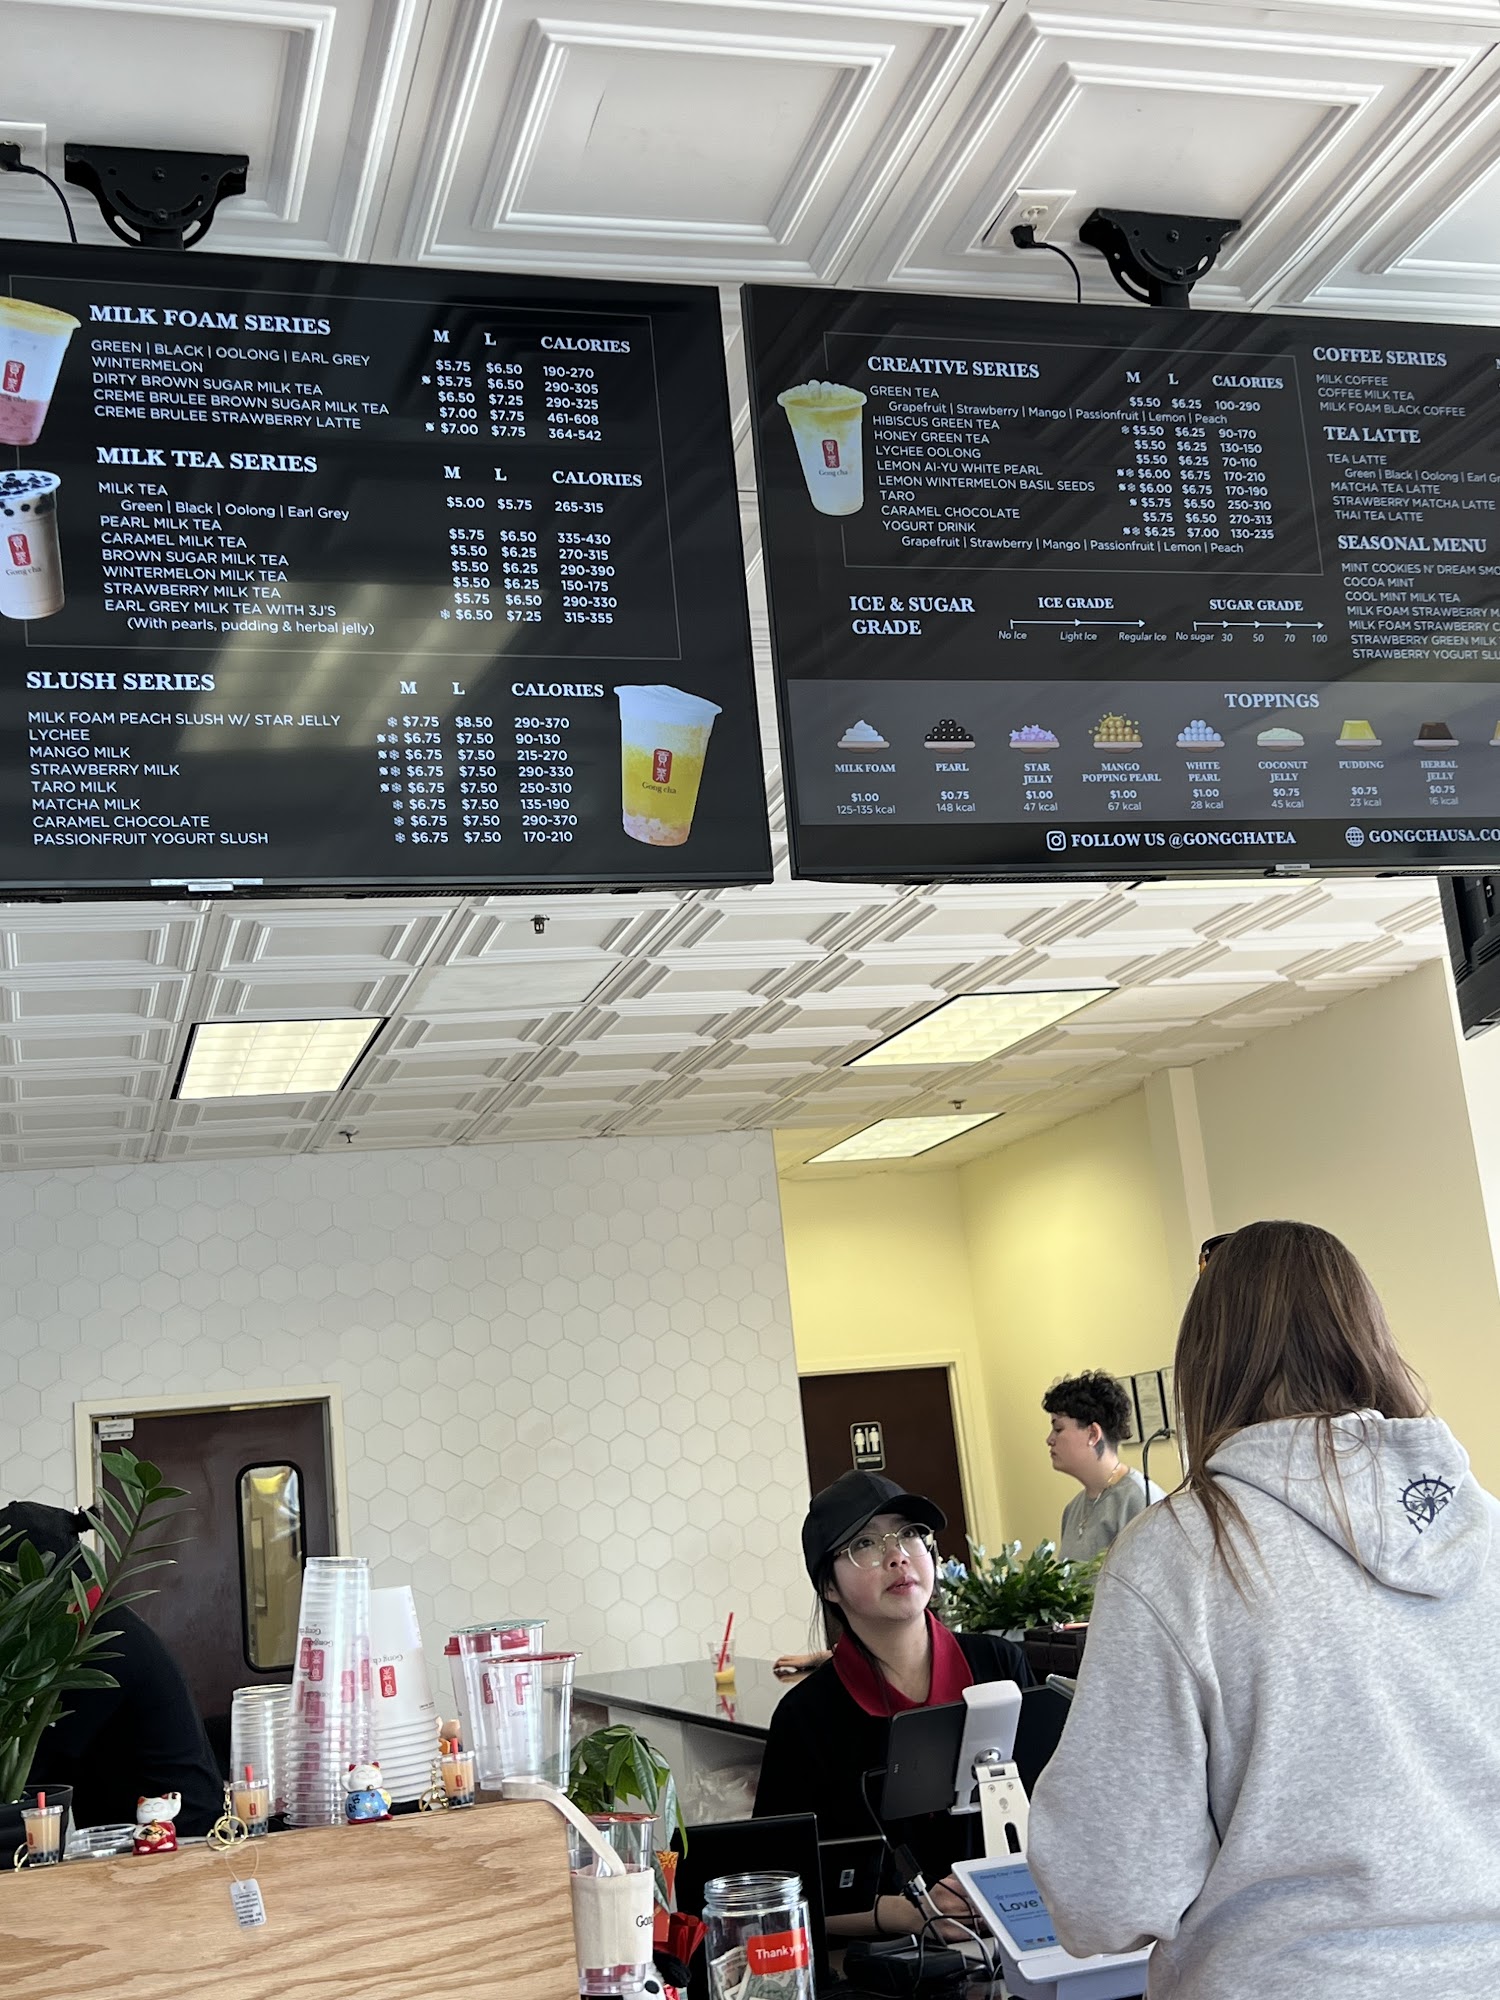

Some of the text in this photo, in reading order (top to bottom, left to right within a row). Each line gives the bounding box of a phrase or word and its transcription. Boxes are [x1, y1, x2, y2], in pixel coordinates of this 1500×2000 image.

[89, 304, 331, 335] MILK FOAM SERIES
[433, 329, 630, 353] M L CALORIES
[1312, 346, 1447, 366] COFFEE SERIES
[91, 355, 203, 373] WINTERMELON
[435, 358, 594, 378] $5.75 $6.50 190-270
[867, 356, 1039, 378] CREATIVE SERIES
[92, 372, 323, 395] DIRTY BROWN SUGAR MILK TEA
[1125, 371, 1283, 389] M L CALORIES
[1315, 374, 1388, 386] MILK COFFEE
[869, 385, 939, 398] GREEN TEA
[93, 388, 389, 414] CREME BRULEE BROWN SUGAR MILK TEA
[437, 390, 598, 410] $6.50 $7.25 290-325
[1129, 396, 1260, 411] $5.50 $6.25 100-290
[94, 404, 361, 429] CREME BRULEE STRAWBERRY LATTE
[439, 406, 599, 425] $7.00 $7.75 461-608
[872, 415, 1000, 429] HIBISCUS GREEN TEA
[1322, 426, 1421, 443] TEA LATTE
[96, 446, 317, 472] MILK TEA SERIES
[875, 445, 981, 458] LYCHEE OOLONG
[98, 481, 168, 496] MILK TEA
[878, 475, 1095, 491] LEMON WINTERMELON BASIL SEEDS
[879, 490, 915, 501] TARO
[446, 495, 603, 513] $5.00 $5.75 265-315
[100, 515, 222, 531] PEARL MILK TEA
[1334, 509, 1423, 522] THAI TEA LATTE
[100, 531, 247, 548] CARAMEL MILK TEA
[448, 527, 611, 545] $5.75 $6.50 335-430
[1337, 534, 1486, 552] SEASONAL MENU
[102, 548, 289, 566] BROWN SUGAR MILK TEA
[104, 599, 336, 616] EARL GREY MILK TEA WITH 3J'S
[849, 595, 975, 612] ICE & SUGAR
[1037, 596, 1114, 609] ICE GRADE
[1209, 598, 1303, 611] SUGAR GRADE
[852, 619, 922, 635] GRADE
[998, 630, 1027, 639] No Ice
[1060, 631, 1097, 642] Light Ice
[1252, 633, 1264, 642] 50
[1312, 634, 1328, 643] 100
[26, 671, 215, 691] SLUSH SERIES
[399, 680, 604, 697] M L CALORIES
[1224, 693, 1319, 708] TOPPINGS
[28, 711, 340, 726] MILK FOAM PEACH SLUSH W/ STAR JELLY
[402, 715, 569, 728] $7.75 $8.50 290-370
[28, 728, 90, 740] LYCHEE
[403, 731, 560, 745] $6.75 $7.50 90-130
[29, 745, 130, 758] MANGO MILK
[834, 763, 896, 772] MILK FOAM
[935, 762, 969, 771] PEARL
[1185, 761, 1220, 770] WHITE
[1338, 760, 1384, 768] PUDDING
[1188, 773, 1221, 781] PEARL
[642, 782, 662, 794] Gong
[940, 790, 969, 800] $0.75
[1351, 786, 1378, 795] $0.75
[851, 792, 879, 802] $1.00
[1190, 800, 1224, 809] 28 kcal
[32, 815, 210, 828] CARAMEL CHOCOLATE
[33, 832, 268, 845] PASSIONFRUIT YOGURT SLUSH
[1070, 831, 1296, 848] FOLLOW US @GONGCHATEA
[999, 1899, 1038, 1912] Love
[755, 1945, 789, 1960] Thank
